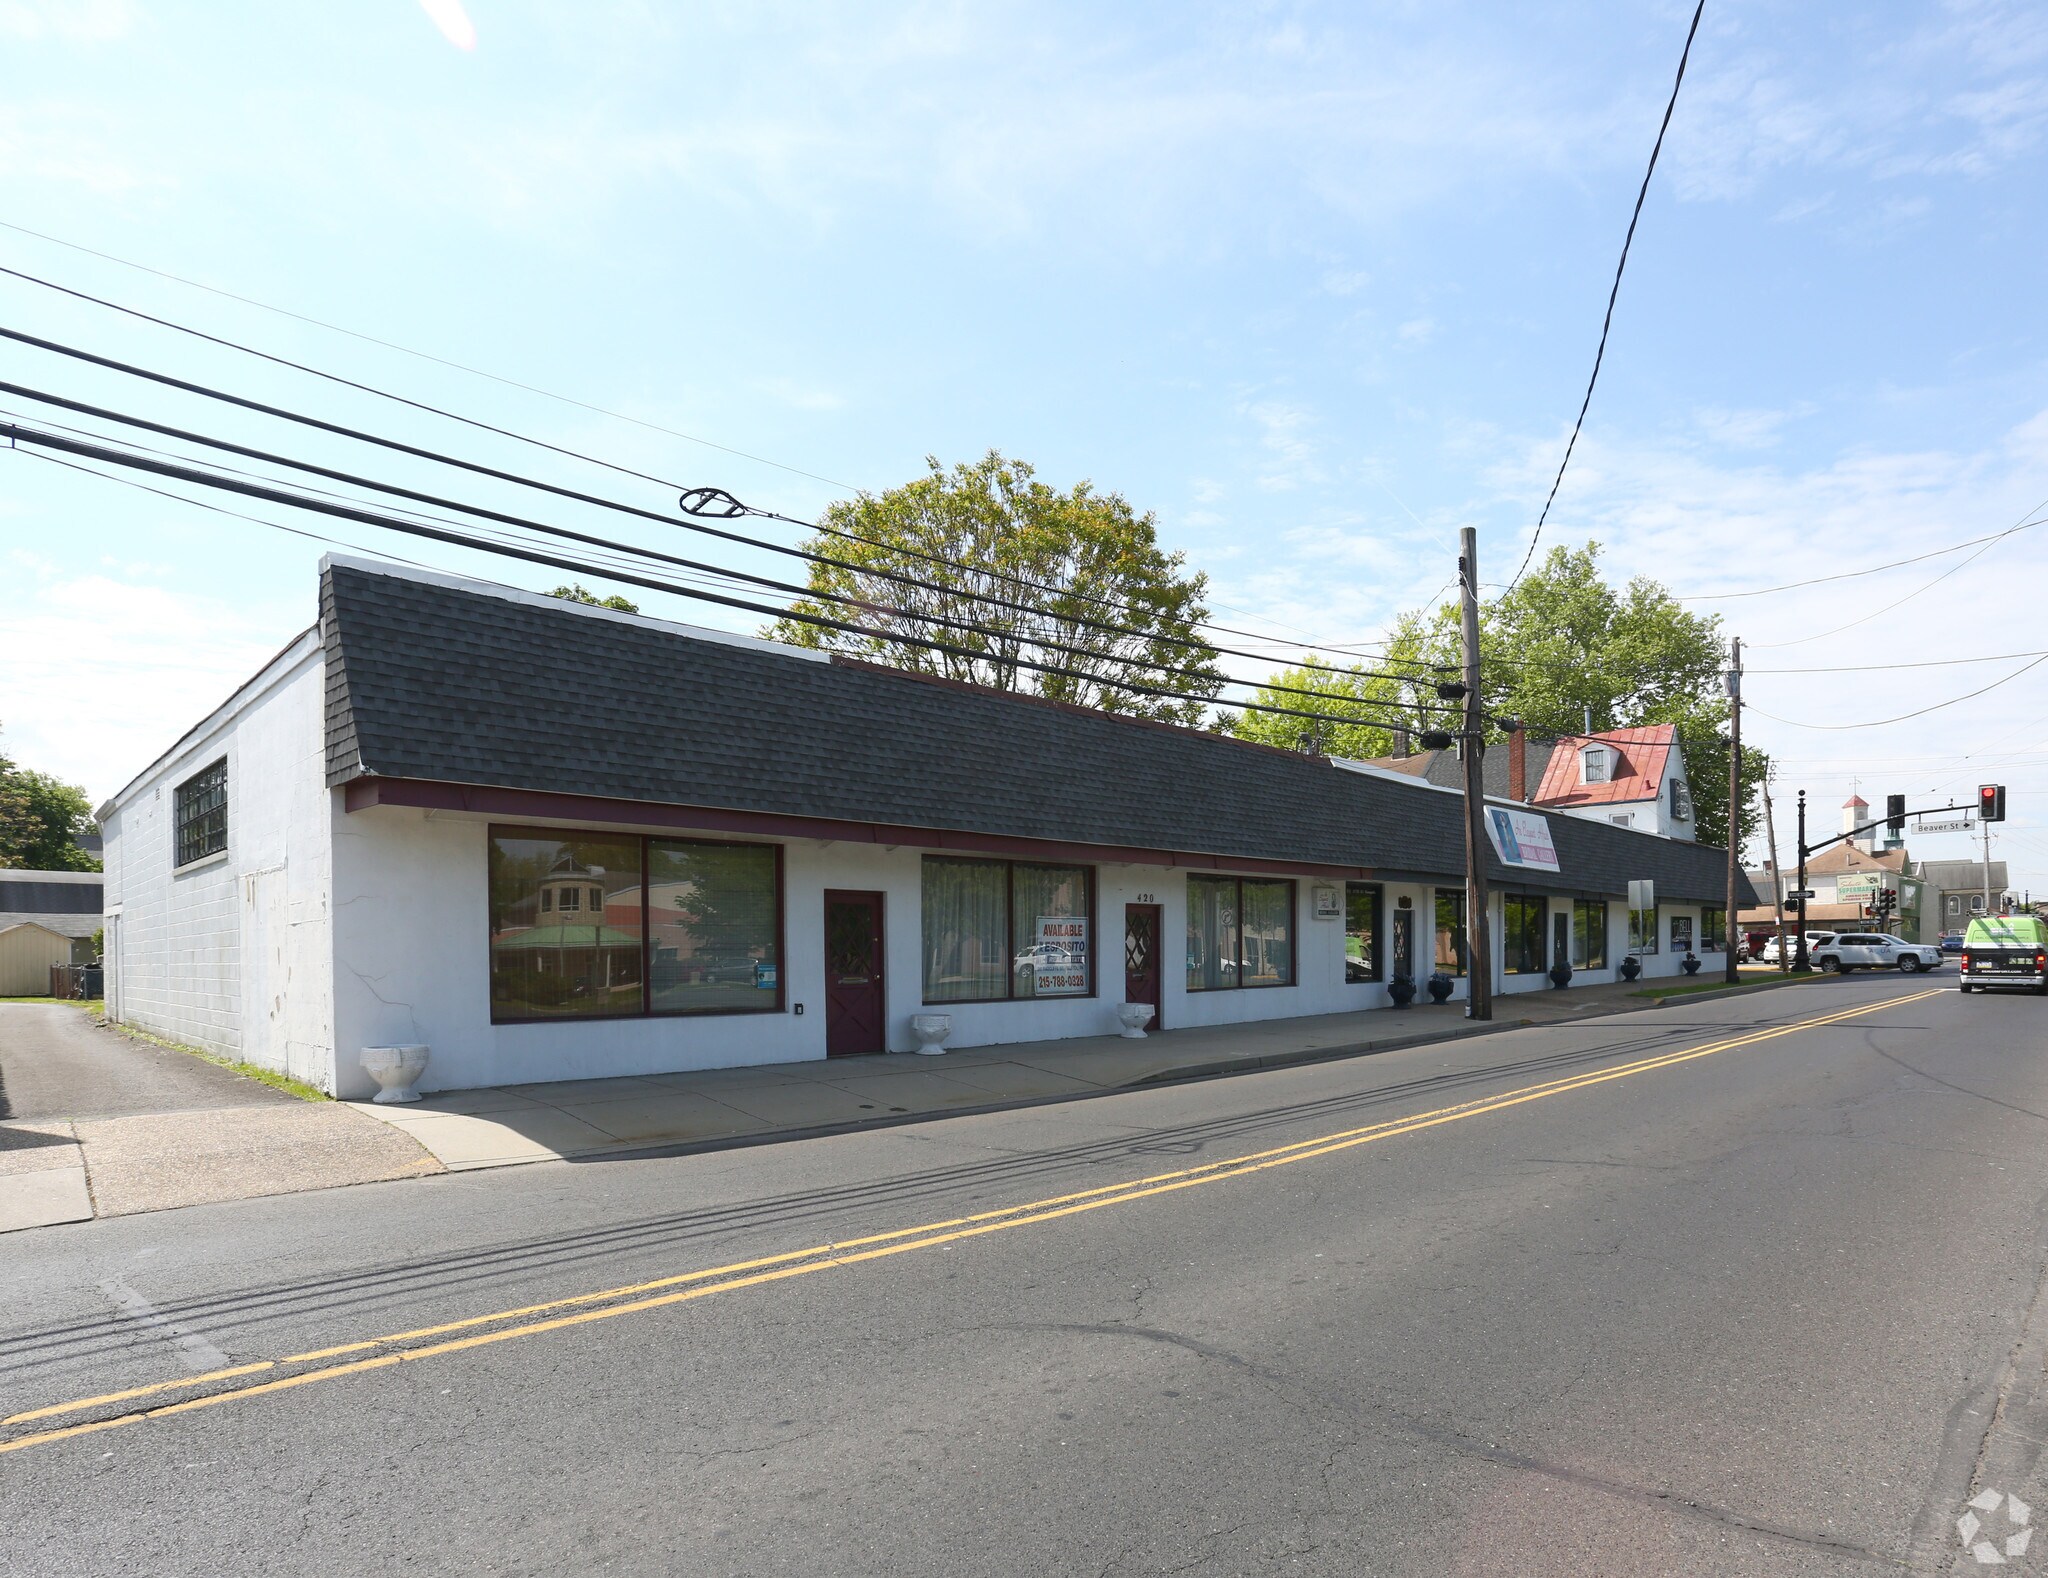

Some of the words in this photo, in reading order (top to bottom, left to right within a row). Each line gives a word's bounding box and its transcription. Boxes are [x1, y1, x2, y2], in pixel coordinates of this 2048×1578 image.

[1918, 824, 1947, 832] Beaver
[1137, 893, 1154, 903] 420
[1043, 924, 1083, 937] AVAILABLE
